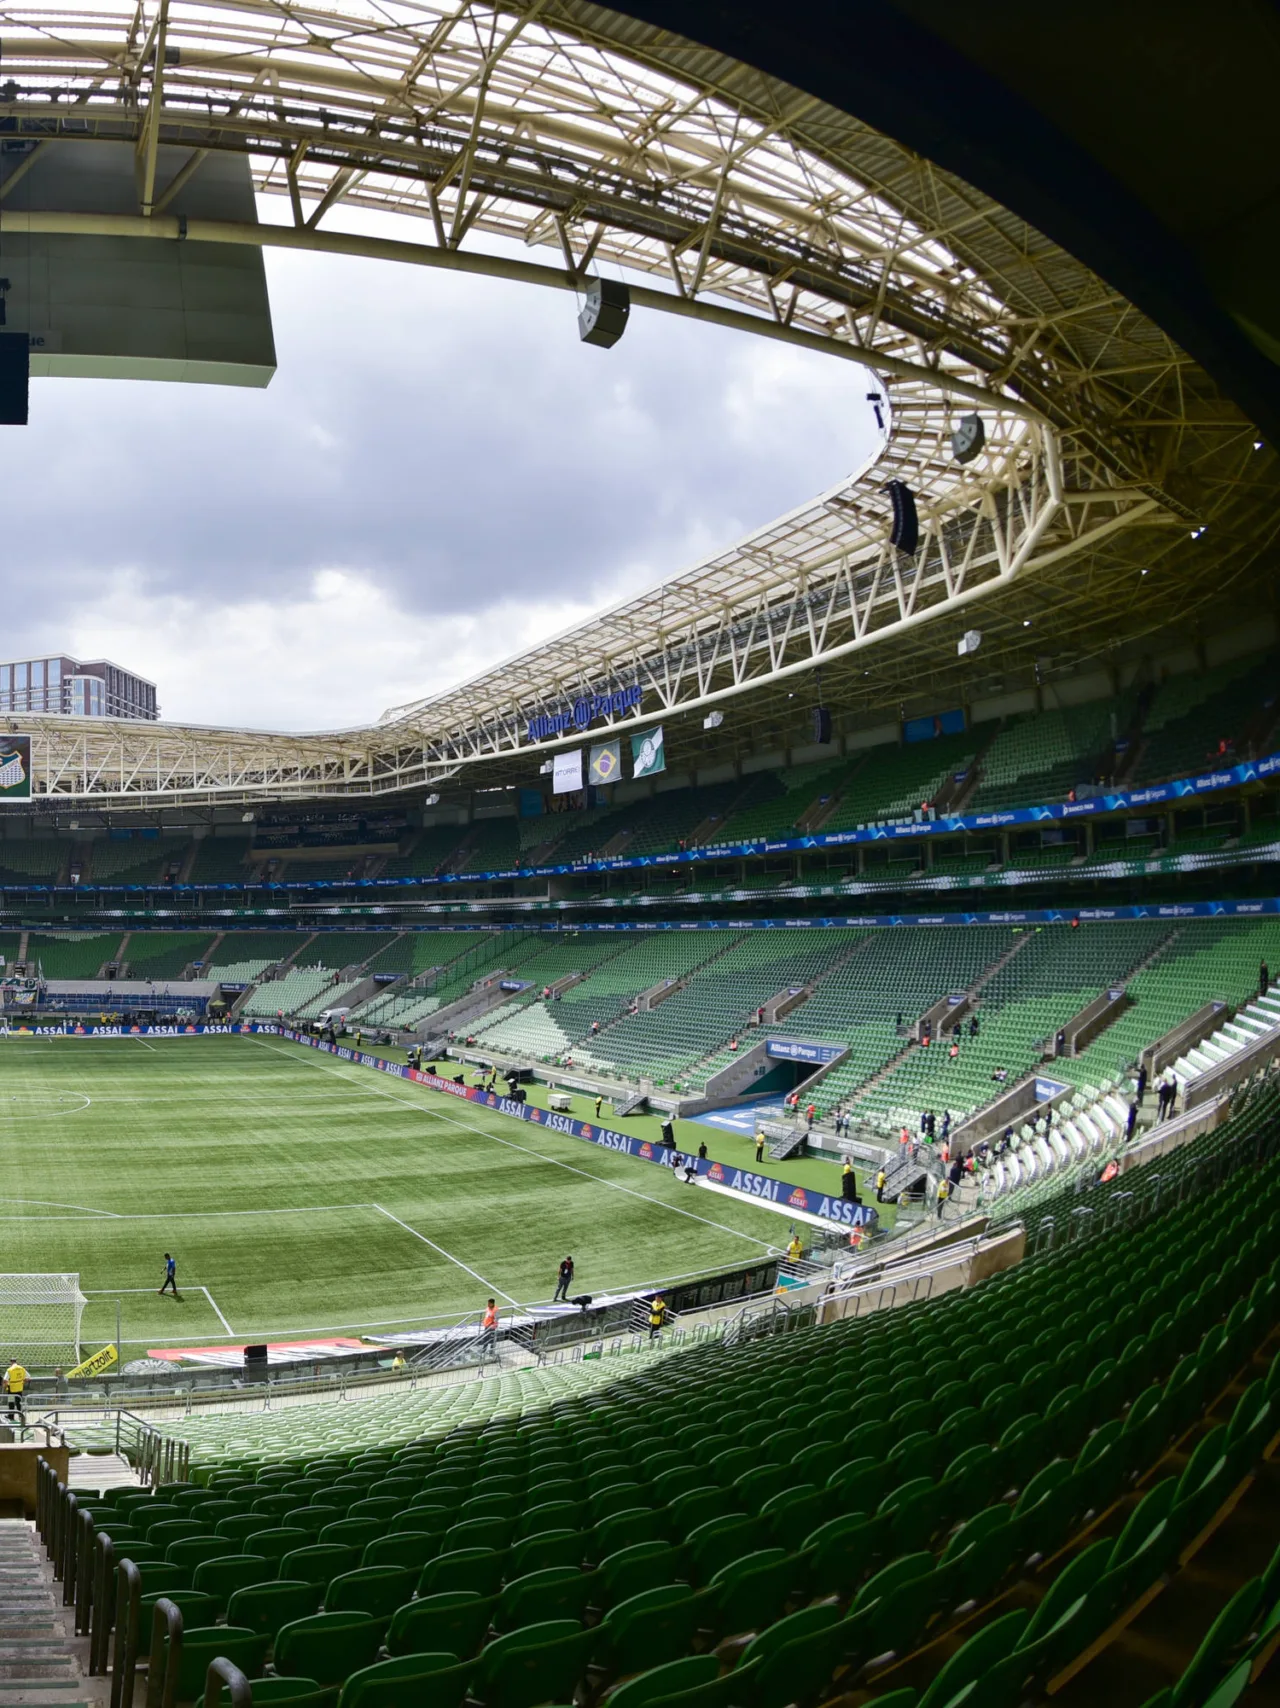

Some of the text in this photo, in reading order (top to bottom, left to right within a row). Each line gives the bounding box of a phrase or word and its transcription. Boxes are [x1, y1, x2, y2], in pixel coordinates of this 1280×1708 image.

[527, 685, 643, 740] Allianz Parque
[423, 1074, 467, 1096] ALLIANZ PARQUE
